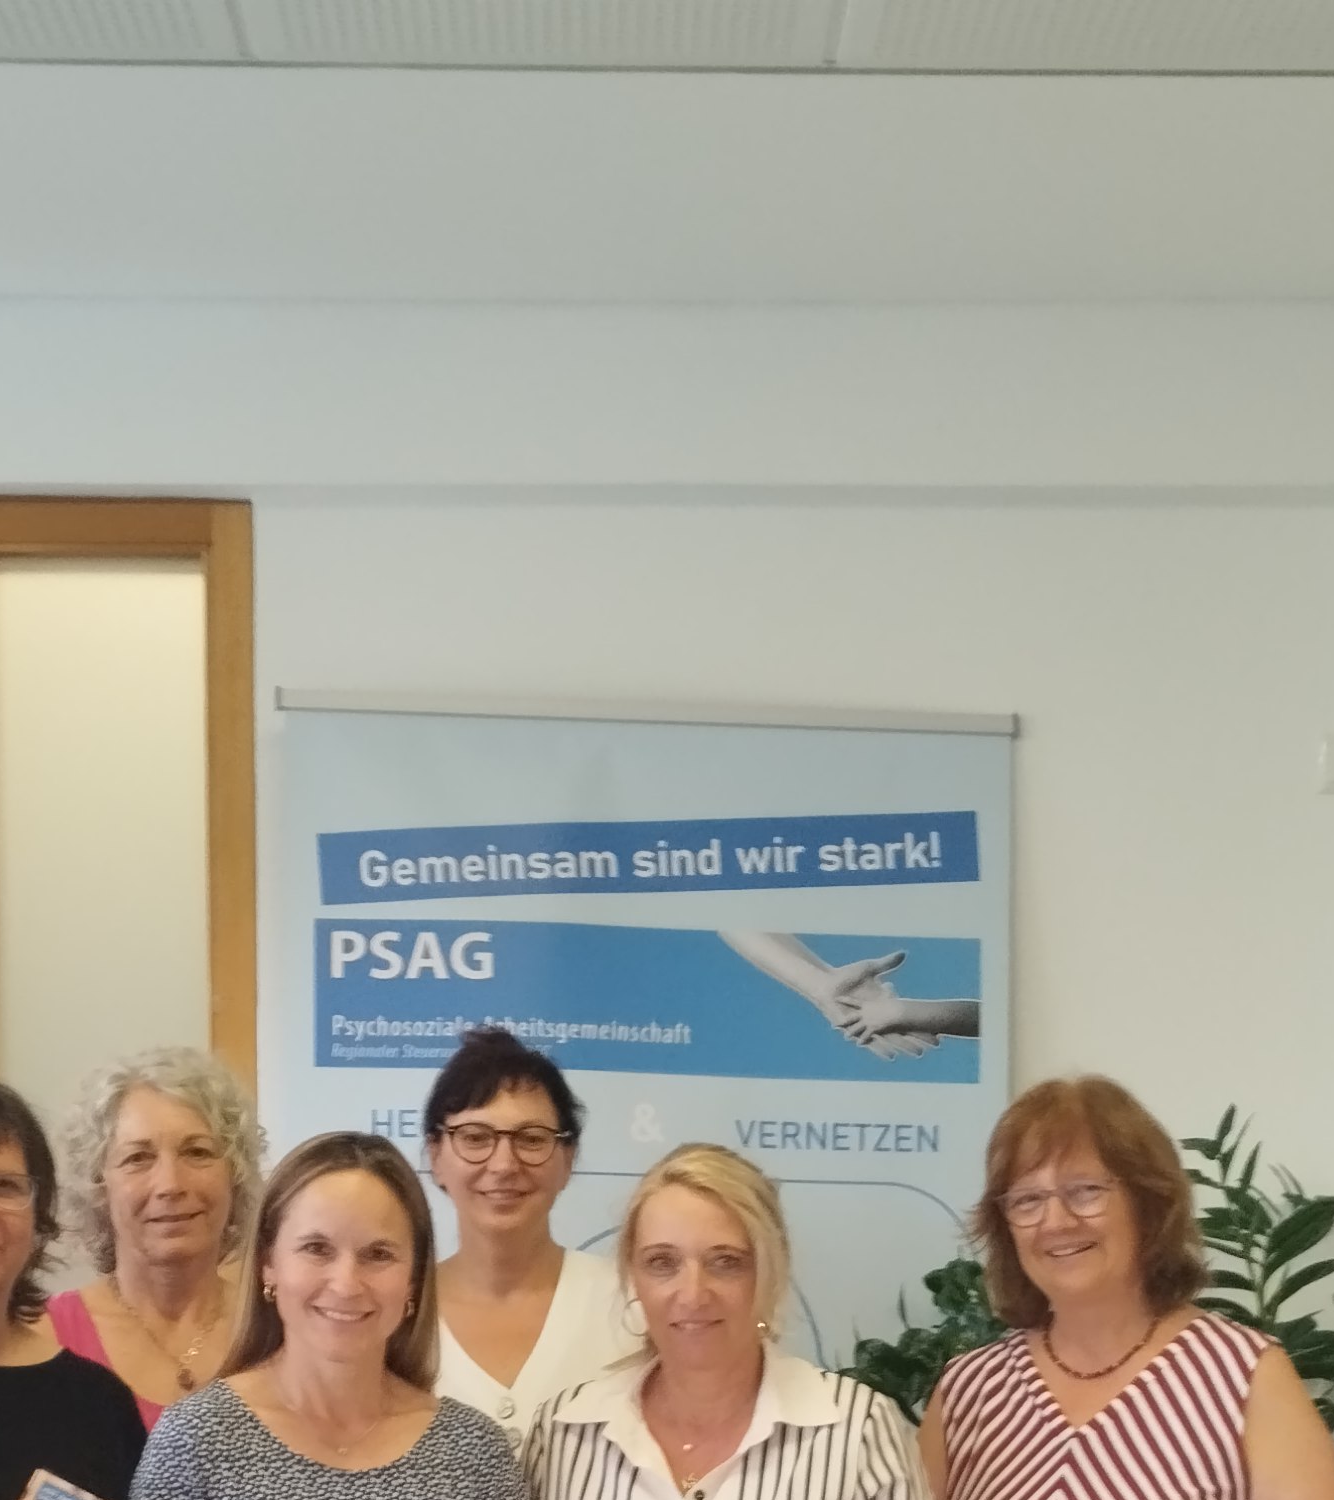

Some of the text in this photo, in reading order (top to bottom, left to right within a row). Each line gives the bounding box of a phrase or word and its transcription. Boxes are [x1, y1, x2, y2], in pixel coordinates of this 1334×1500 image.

[359, 831, 942, 888] Gemeinsam sind wir stark!
[330, 930, 495, 981] PSAG
[331, 1014, 474, 1042] Psychosoziale
[734, 1119, 941, 1153] VERNETZEN
